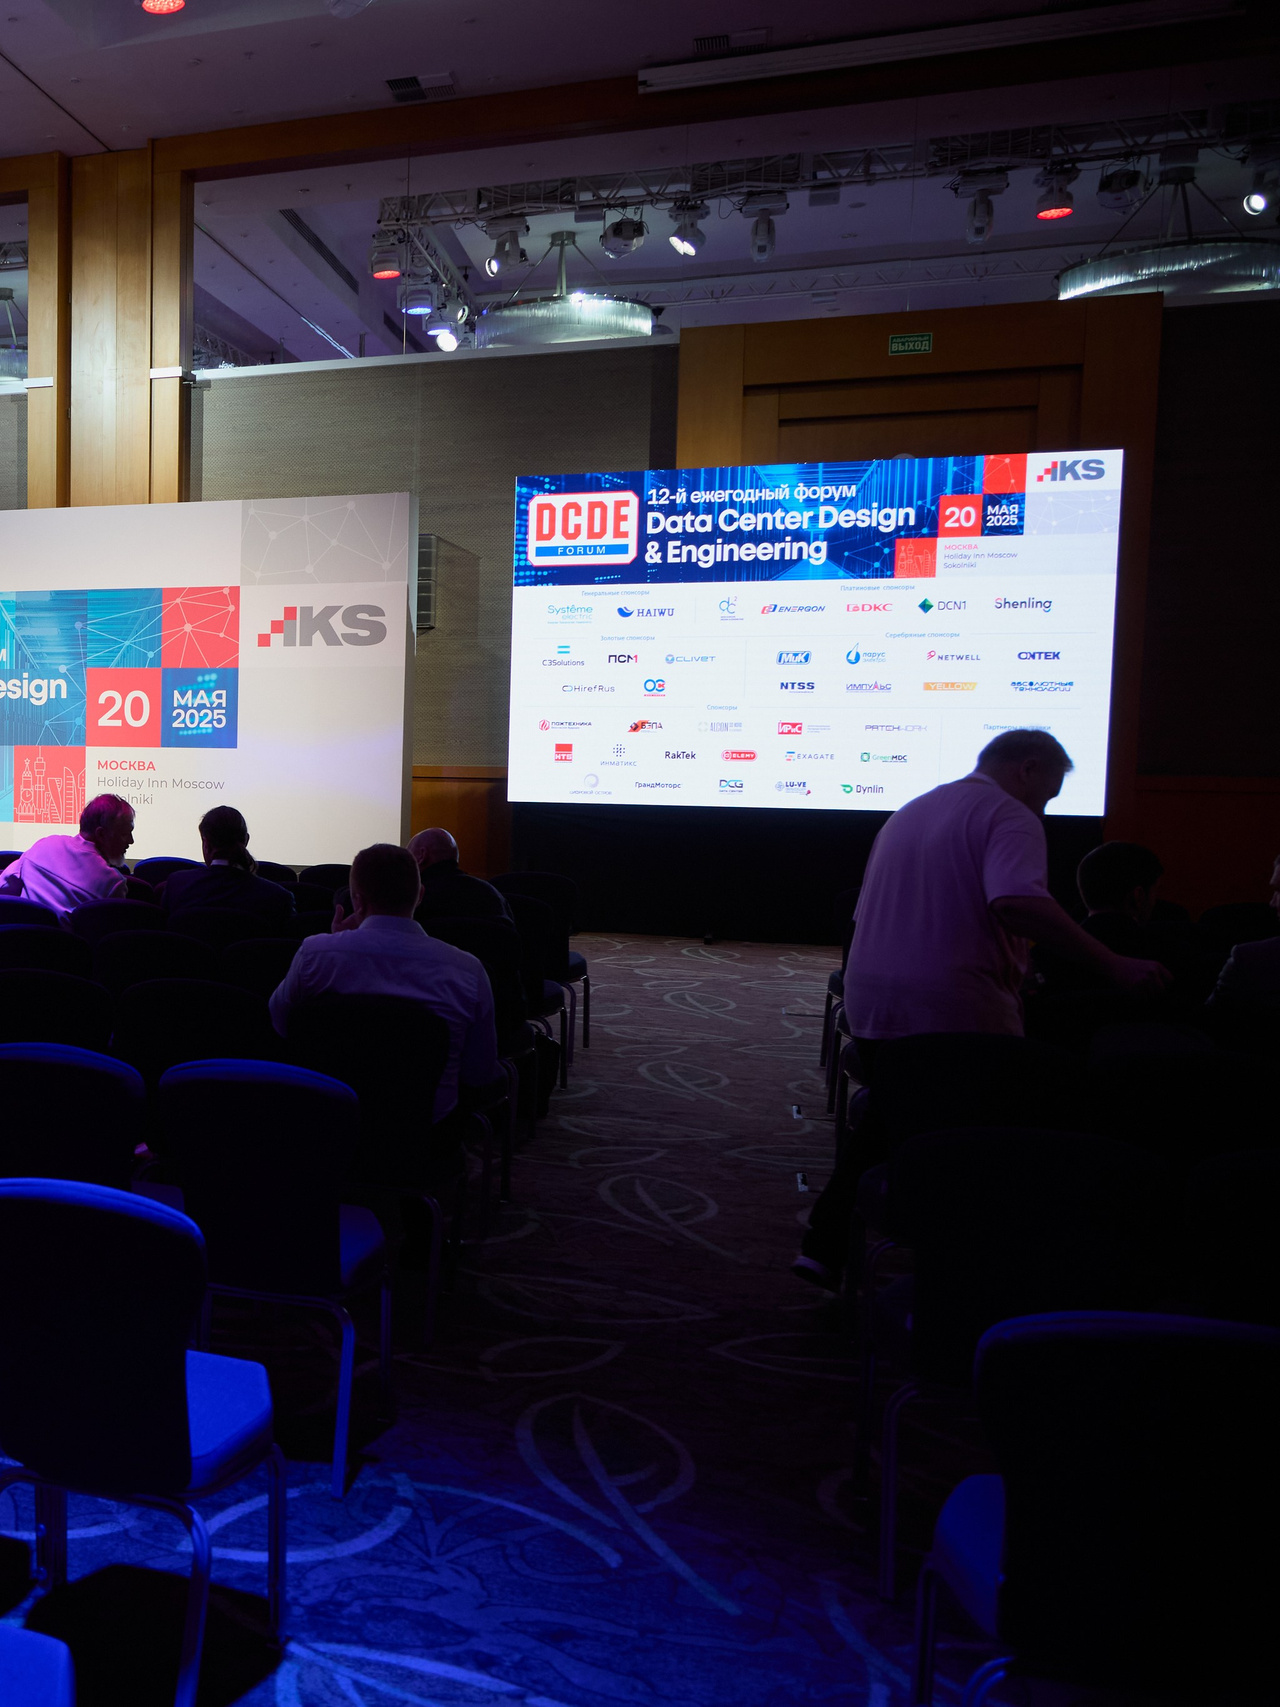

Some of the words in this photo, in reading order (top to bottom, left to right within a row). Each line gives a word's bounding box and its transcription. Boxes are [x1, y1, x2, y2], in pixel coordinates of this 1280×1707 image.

[892, 341, 929, 351] ВЫХОД
[647, 487, 686, 505] 12-й
[690, 484, 790, 504] ежегодный
[793, 482, 857, 503] форум
[987, 504, 1019, 515] МАЯ
[535, 499, 630, 541] DCDE
[646, 511, 713, 534] Data
[718, 508, 814, 531] Center
[818, 502, 915, 533] Design
[944, 506, 976, 528] 20
[986, 515, 1019, 527] 2025
[558, 546, 606, 555] FORUM
[644, 541, 662, 564] &
[667, 536, 828, 568] Engineering
[944, 552, 972, 561] Holiday
[973, 552, 986, 560] Inn
[987, 551, 1018, 560] Moscow
[943, 561, 977, 569] Sokolniki
[778, 605, 826, 613] ENERGON
[937, 600, 967, 611] DCN1
[994, 597, 1052, 612] Shenling
[637, 607, 675, 618] HAIWU
[780, 681, 816, 690] NTSS
[928, 682, 975, 690] YELLOW
[173, 690, 227, 708] МАЯ
[97, 690, 150, 727] 20
[172, 709, 227, 728] 2025
[665, 751, 696, 760] RakTek
[97, 760, 156, 771] МОСКВА
[97, 776, 144, 790] Holiday
[148, 778, 168, 789] Inn
[172, 778, 226, 790] Moscow
[634, 781, 682, 789] ГрандМоторс
[856, 784, 884, 795] Dynlin
